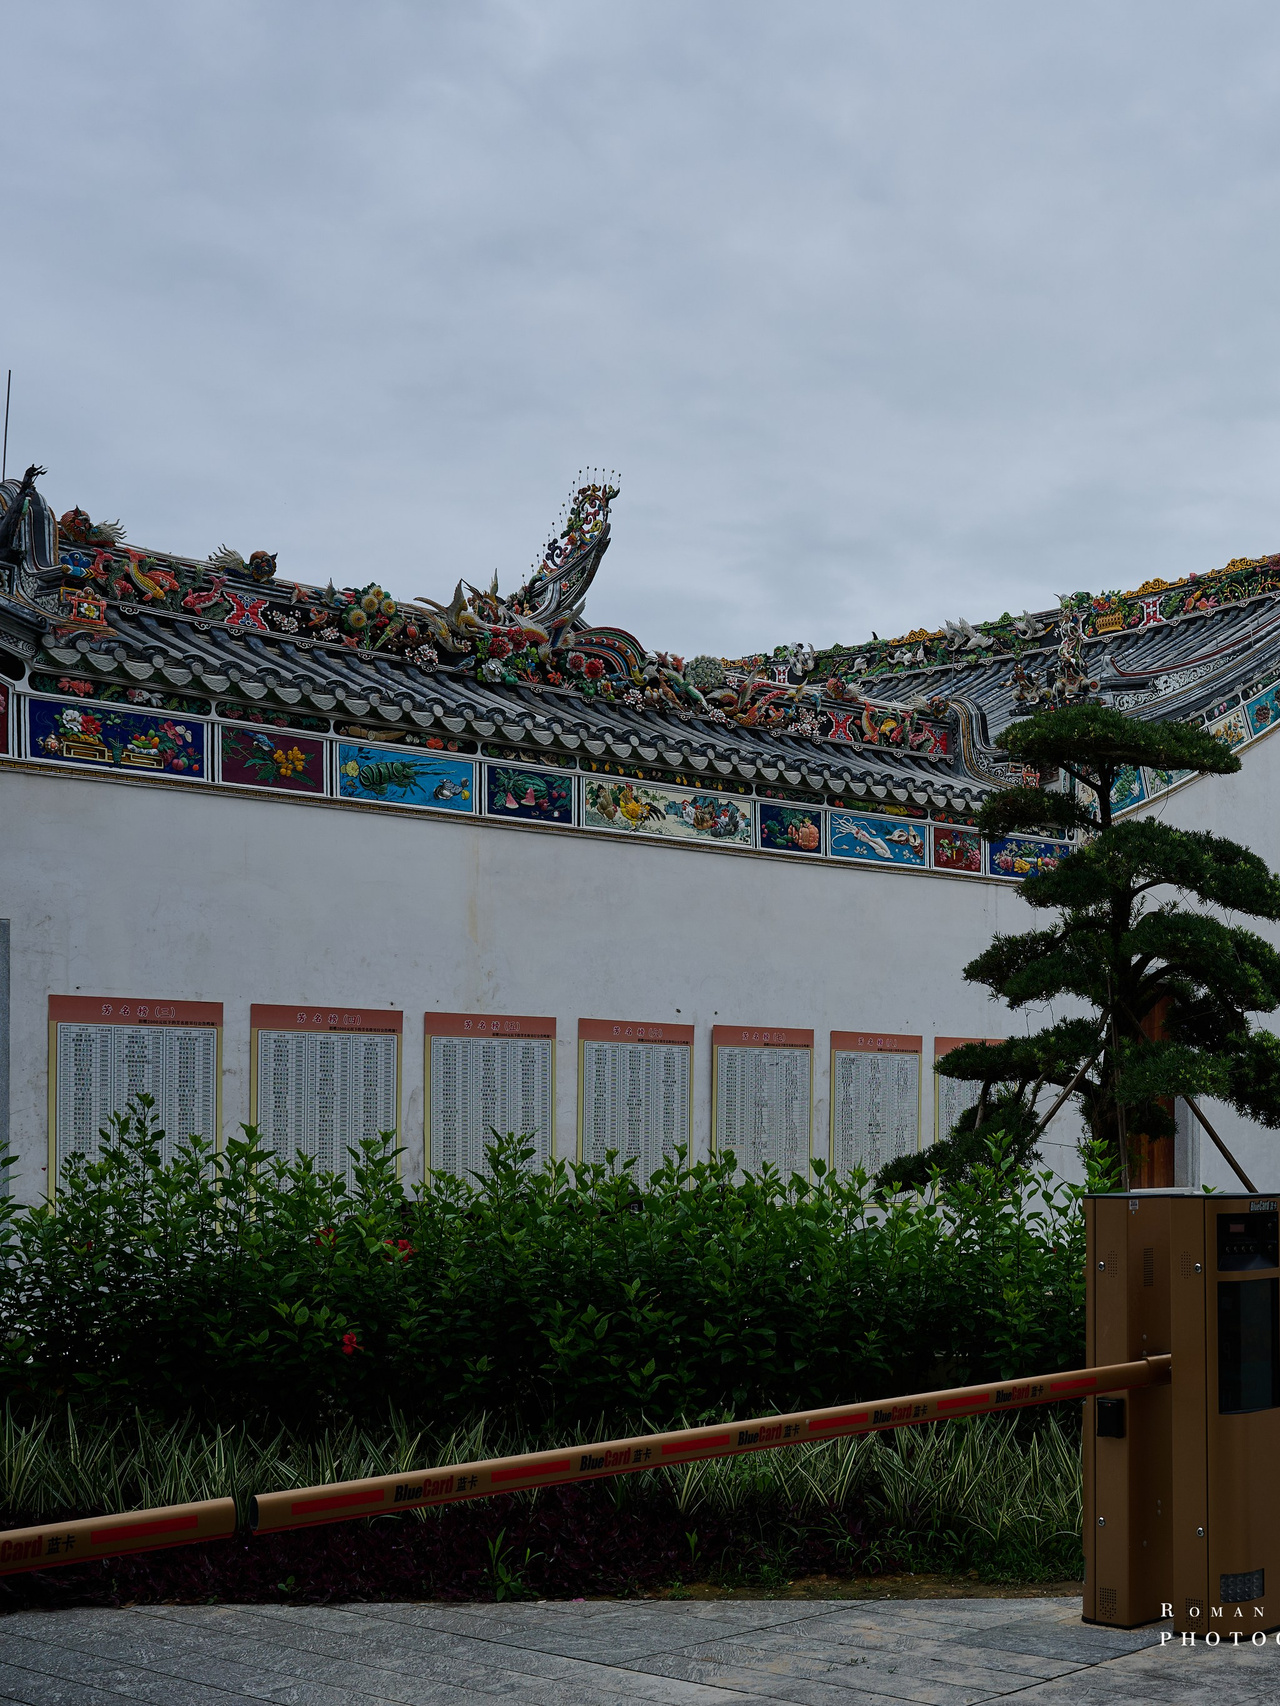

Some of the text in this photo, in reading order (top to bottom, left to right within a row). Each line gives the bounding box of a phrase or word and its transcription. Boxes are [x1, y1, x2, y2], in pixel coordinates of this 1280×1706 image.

[995, 1384, 1030, 1404] BlueCard
[873, 1404, 912, 1424] BlueCard
[738, 1423, 800, 1446] BlueCard 蓝卡
[580, 1447, 652, 1471] BlueCard 蓝卡
[394, 1474, 479, 1502] BlueCard 蓝卡
[45, 1534, 77, 1555] 蓝卡
